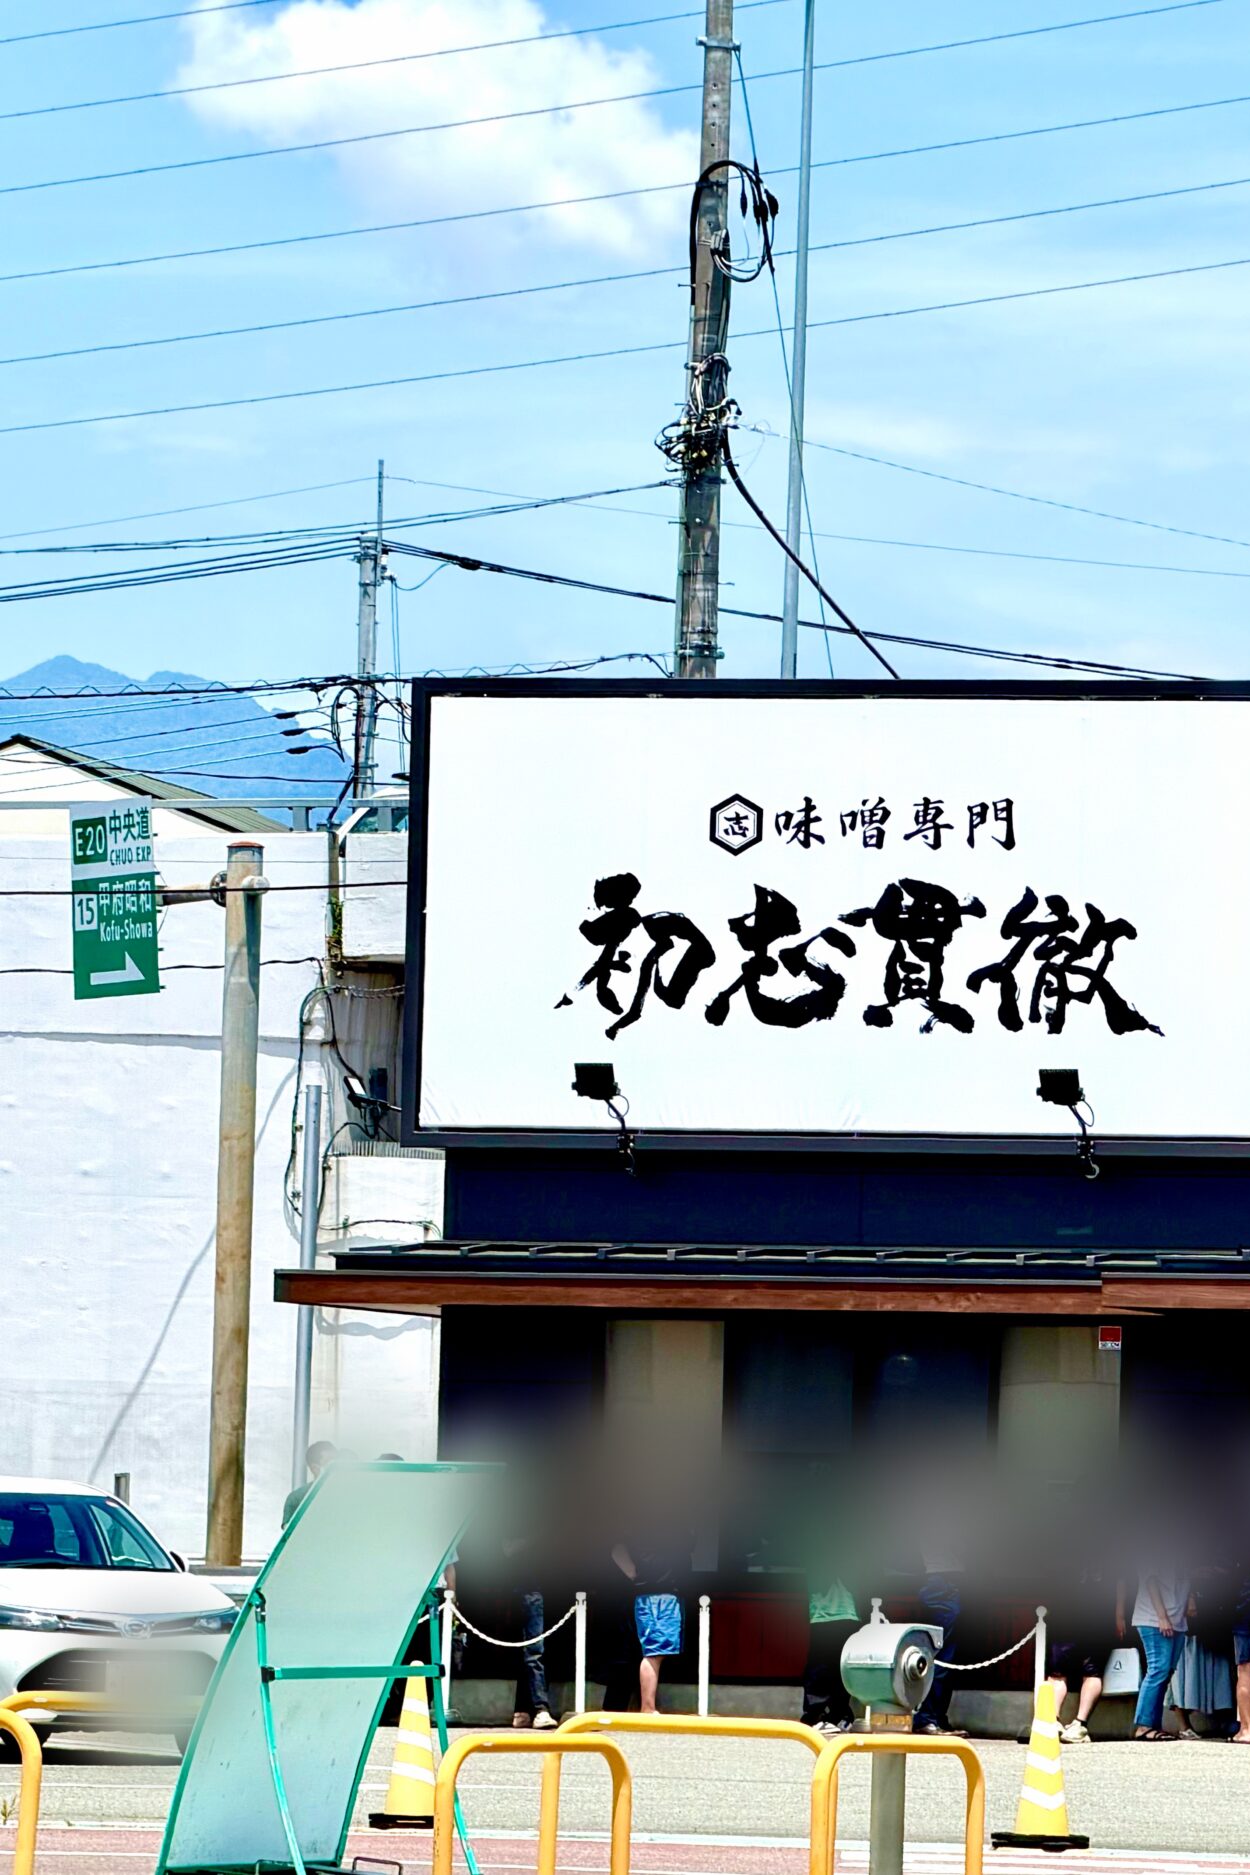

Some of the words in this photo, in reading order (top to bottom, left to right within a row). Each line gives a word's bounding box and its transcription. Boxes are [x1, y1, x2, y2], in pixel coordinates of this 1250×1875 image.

[75, 824, 105, 857] E20
[109, 806, 151, 844] 中央道
[773, 795, 1016, 852] 味噌専門
[109, 849, 133, 866] CHUO
[136, 846, 152, 862] EXP
[77, 898, 94, 925] 15
[98, 878, 152, 917] 甲府昭和
[99, 919, 153, 943] Kofu-Showa
[553, 871, 1166, 1040] 初志貫徹
